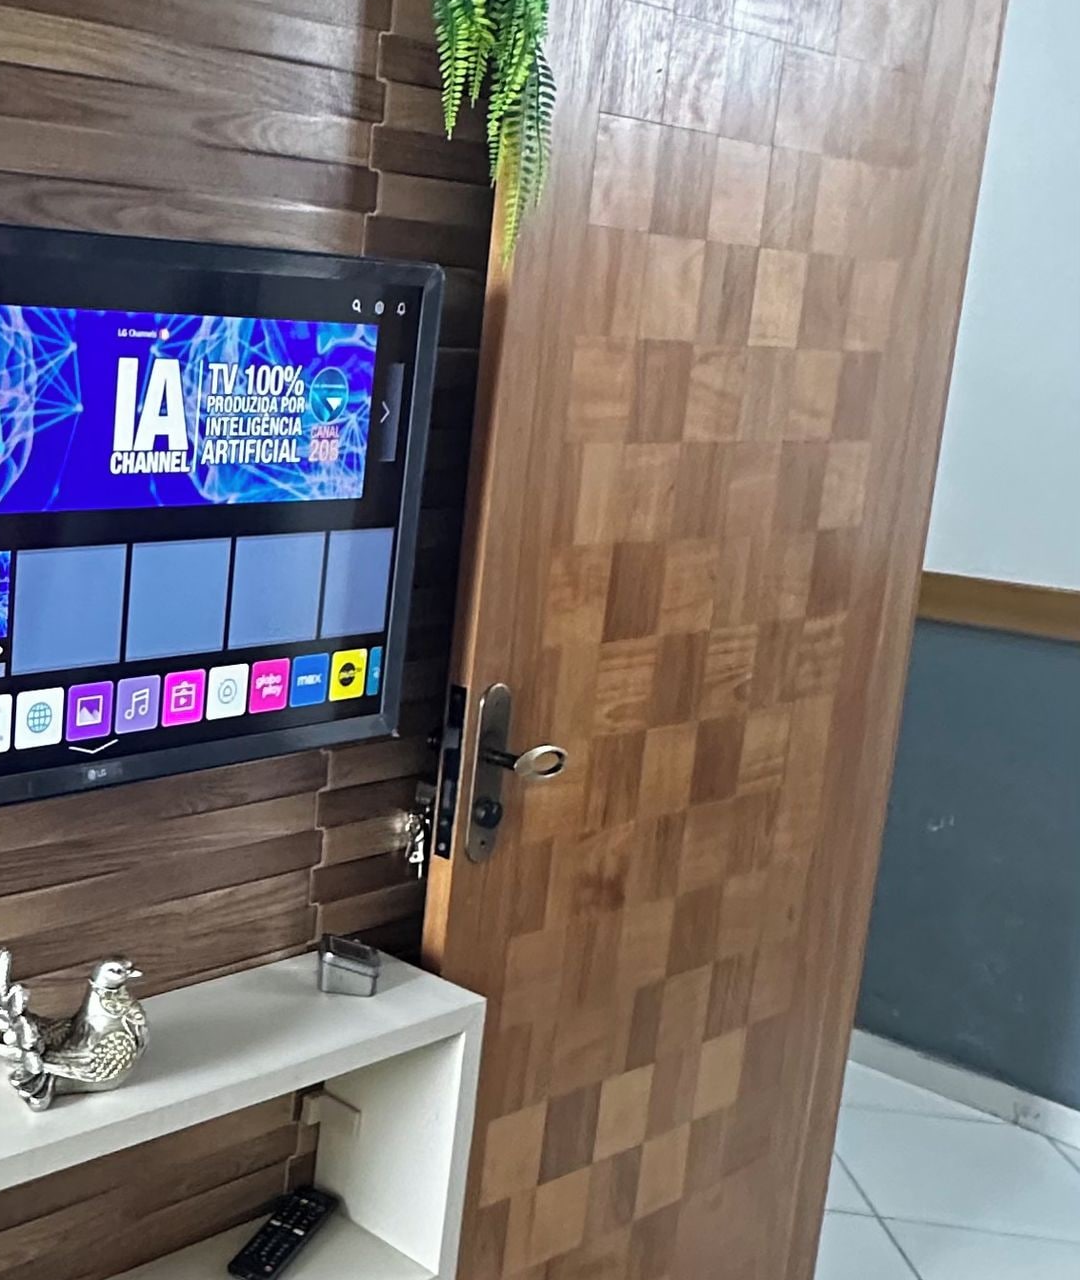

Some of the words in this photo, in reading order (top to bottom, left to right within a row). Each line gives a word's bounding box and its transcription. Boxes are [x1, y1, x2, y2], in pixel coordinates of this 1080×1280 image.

[117, 328, 128, 337] LG
[128, 328, 157, 339] Channels
[208, 363, 239, 395] TV
[245, 364, 305, 397] 100%
[113, 357, 189, 451] IA
[206, 396, 278, 414] PRODUZIDA
[280, 396, 306, 414] POR
[205, 414, 303, 436] INTELIGÊNCIA
[310, 424, 340, 439] CANAL
[110, 450, 191, 474] CHANNEL
[201, 439, 301, 465] ARTIFICIAL
[297, 673, 322, 687] max
